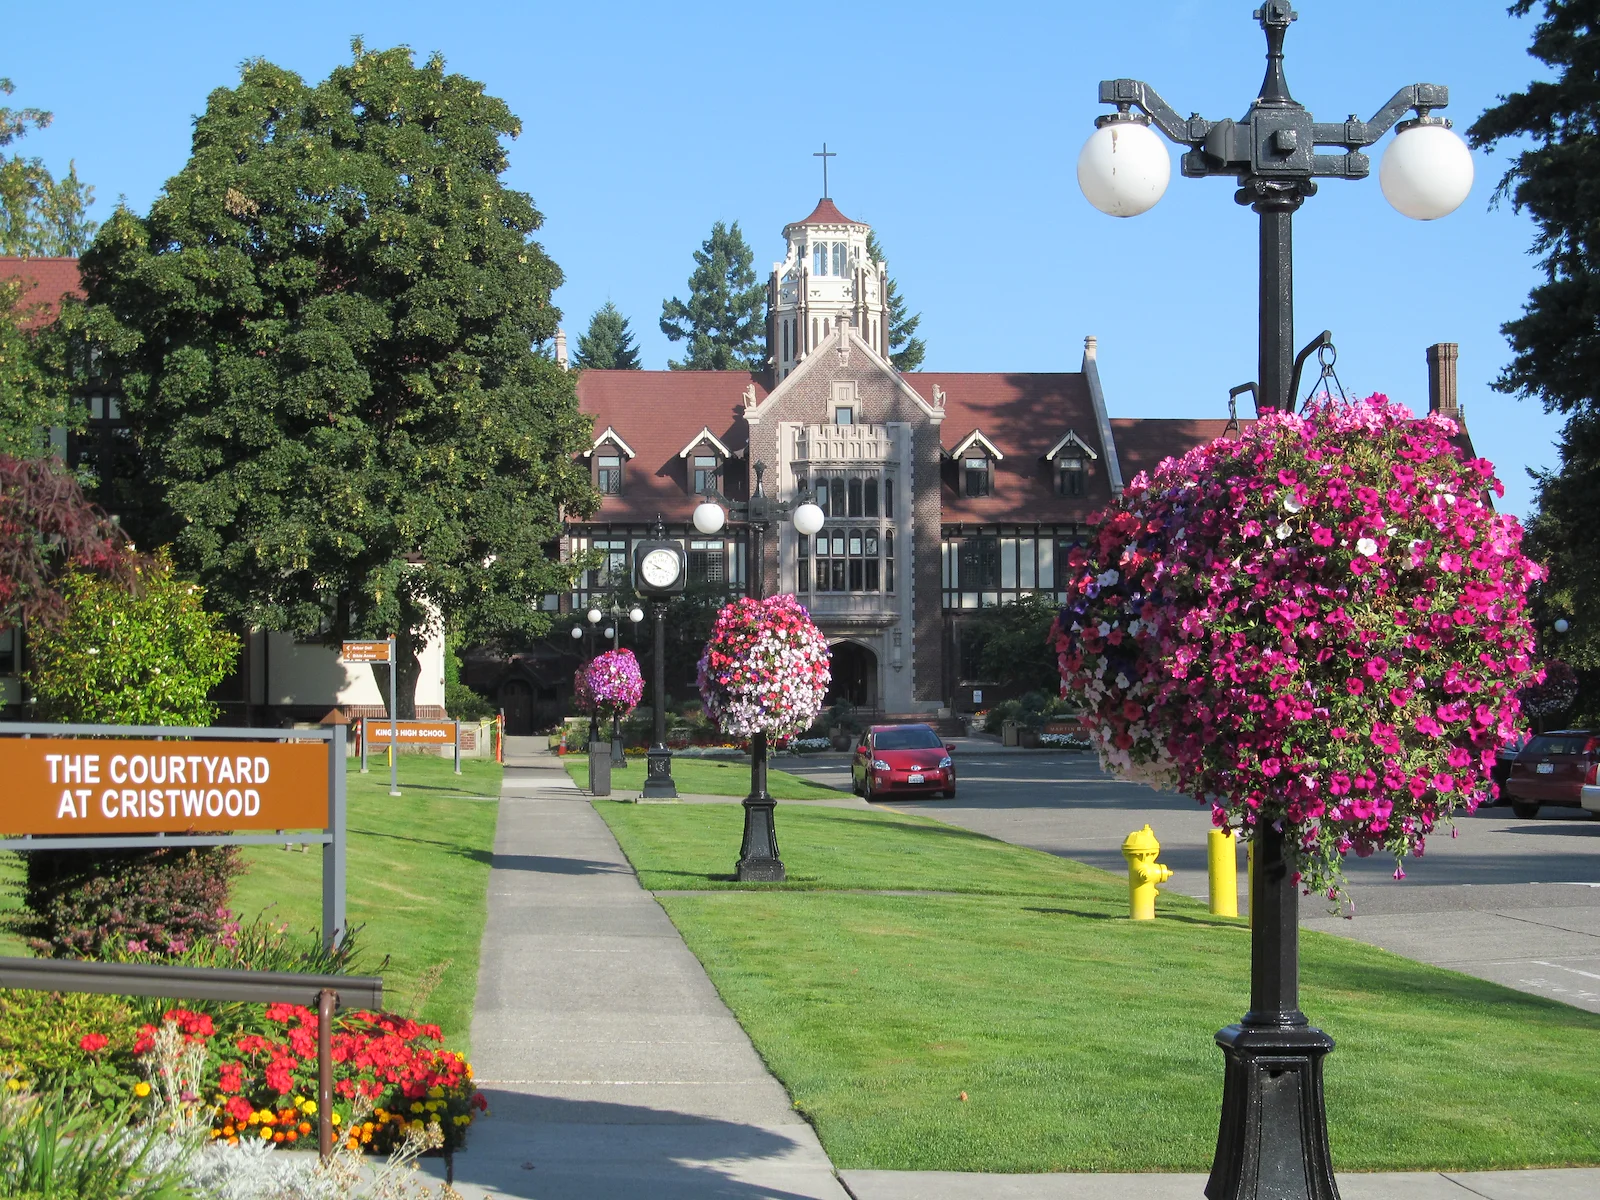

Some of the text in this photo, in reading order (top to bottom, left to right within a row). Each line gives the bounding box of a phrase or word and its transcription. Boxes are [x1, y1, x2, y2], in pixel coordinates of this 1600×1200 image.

[375, 728, 447, 737] KINGS HIGH SCHOOL
[45, 754, 271, 784] THE COURTYARD
[57, 788, 261, 818] AT CRISTWOOD
